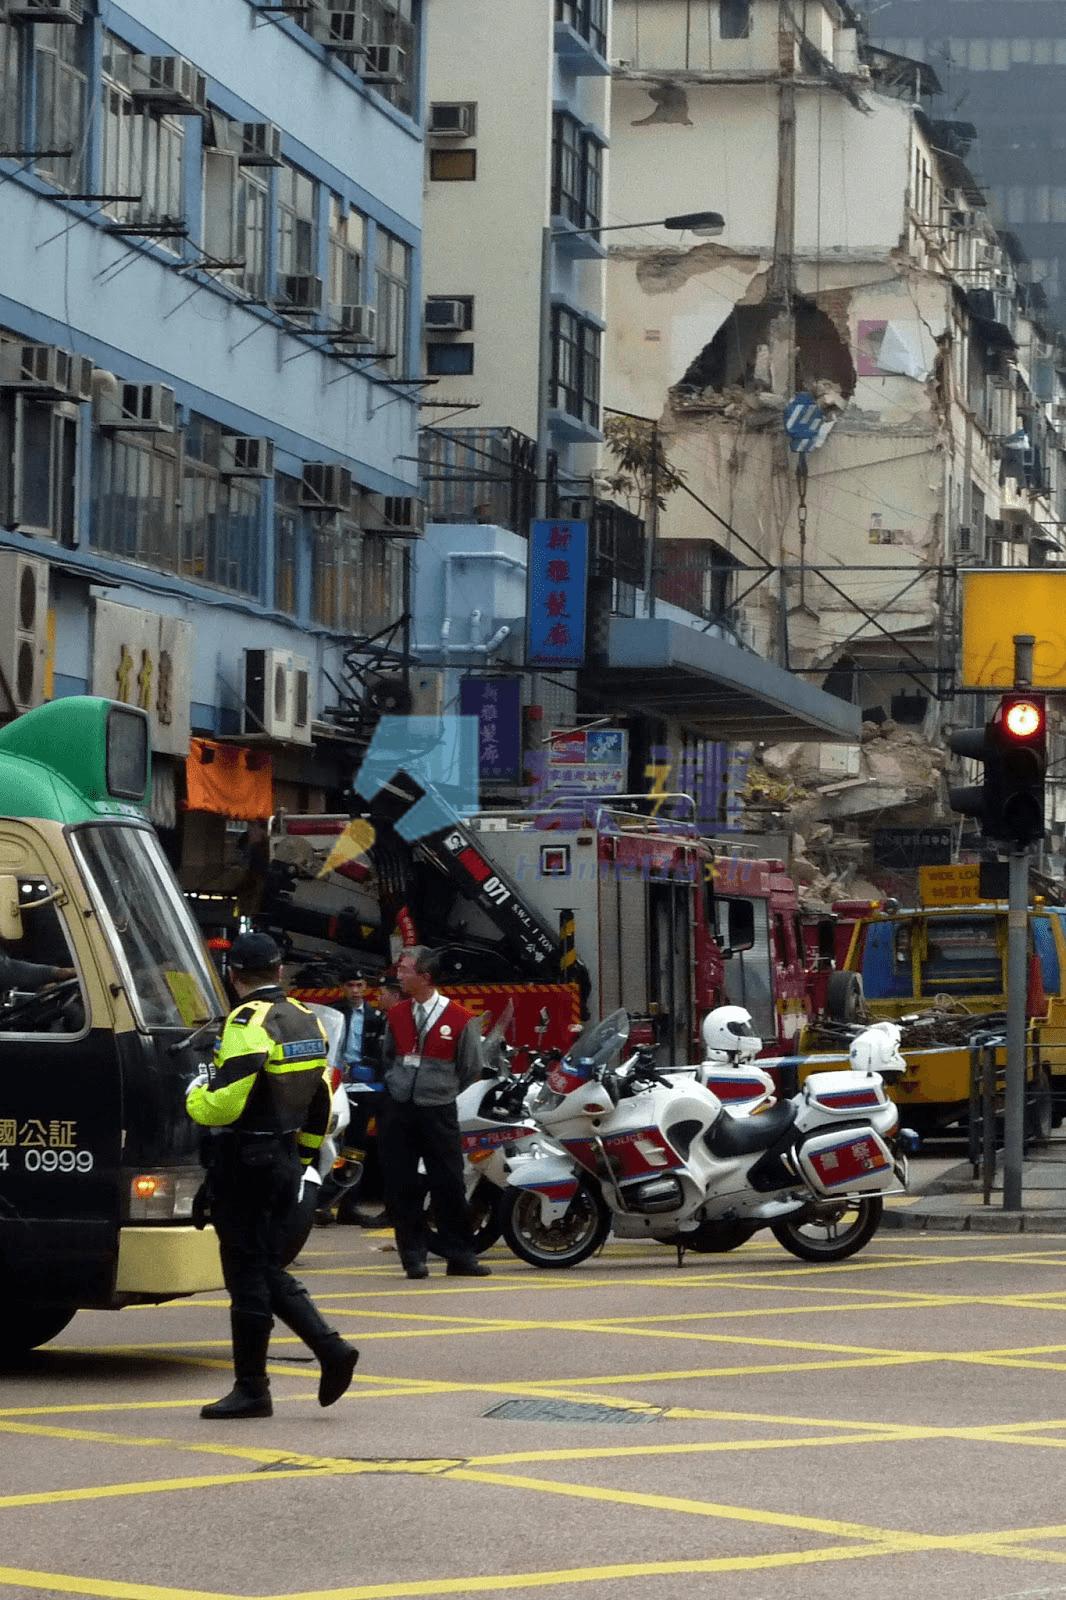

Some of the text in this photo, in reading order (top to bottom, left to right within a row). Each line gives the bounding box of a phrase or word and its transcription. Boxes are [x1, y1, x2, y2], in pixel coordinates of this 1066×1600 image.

[959, 871, 979, 879] LOA
[482, 876, 511, 905] 071
[292, 1043, 319, 1054] POLICE
[606, 1133, 645, 1147] POLICE
[25, 1149, 94, 1173] 0999
